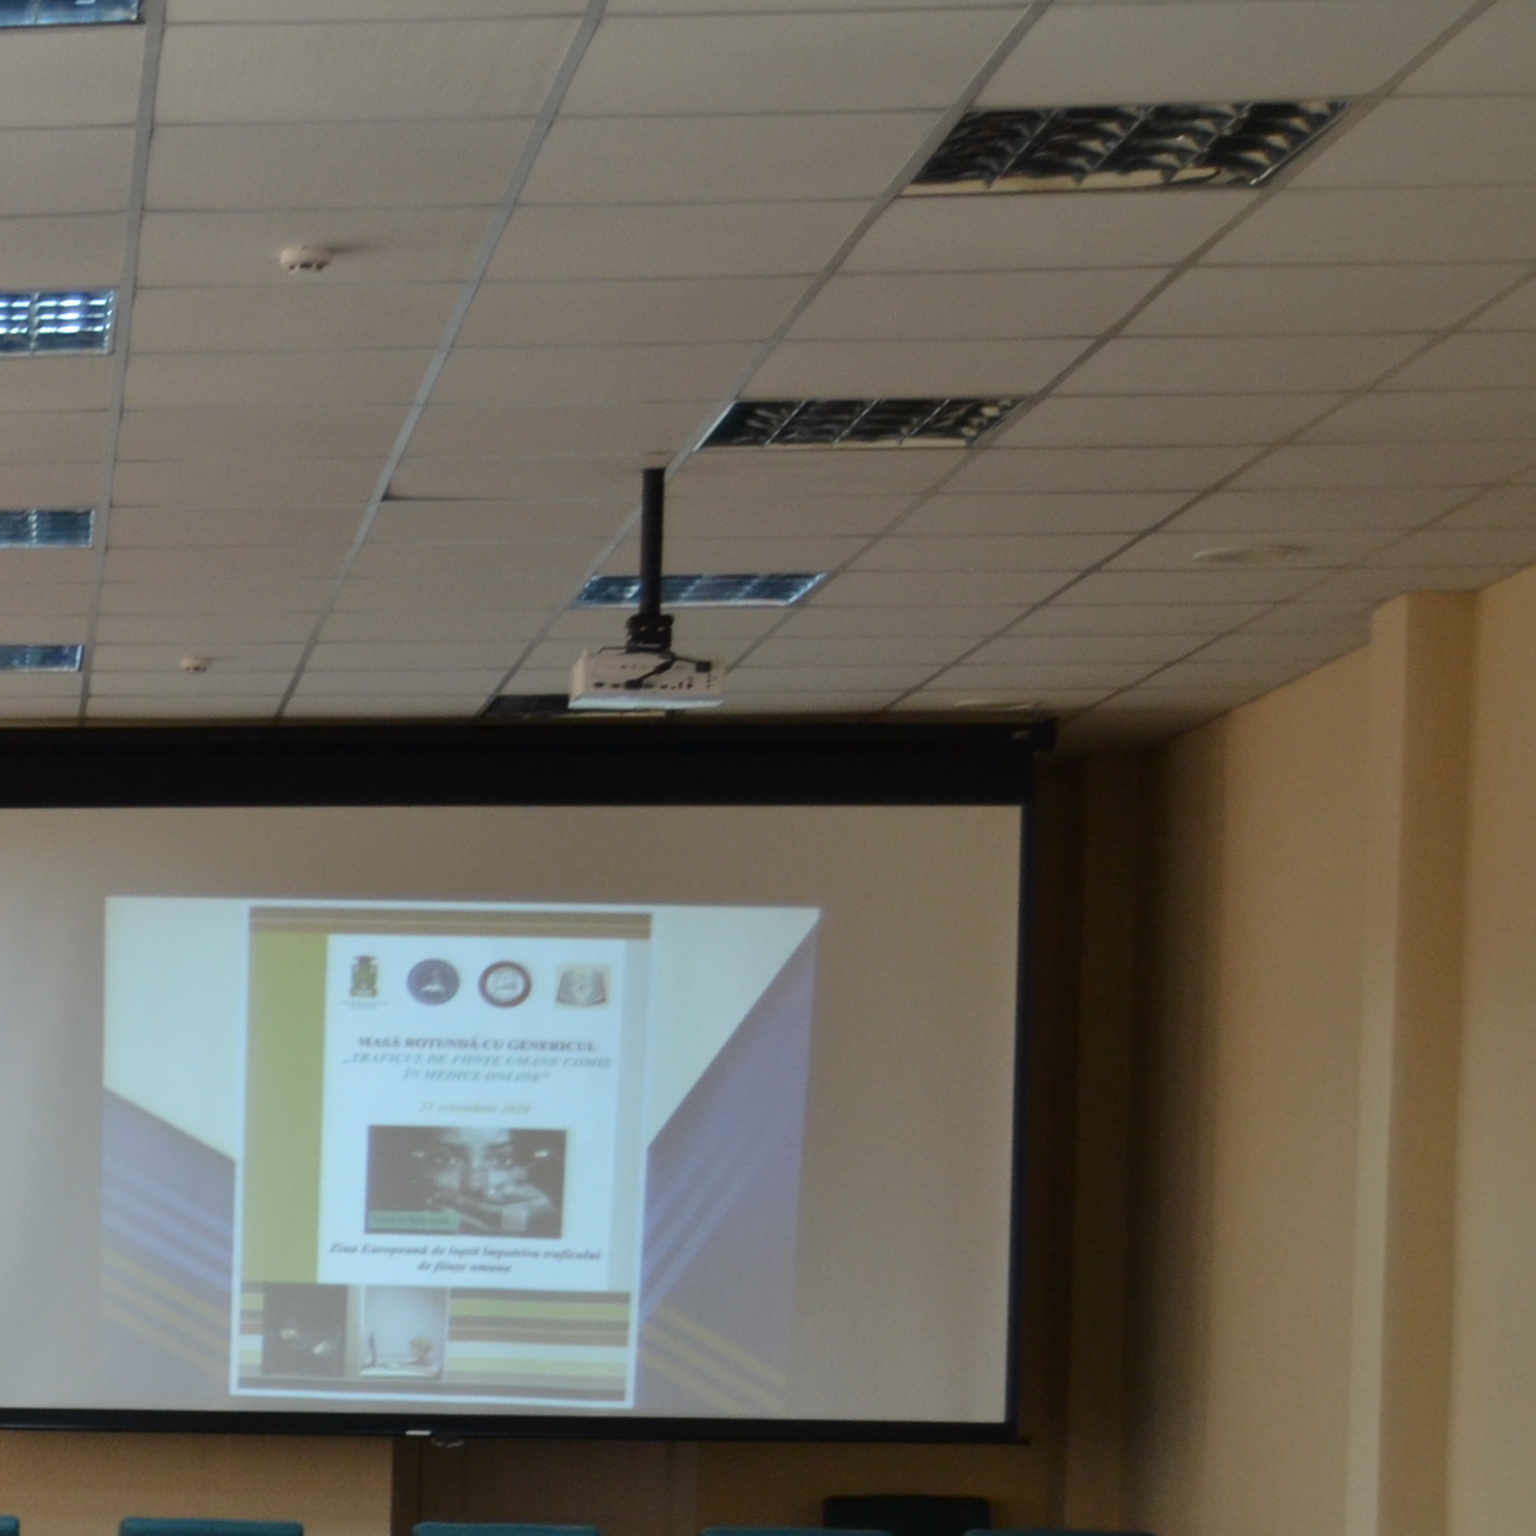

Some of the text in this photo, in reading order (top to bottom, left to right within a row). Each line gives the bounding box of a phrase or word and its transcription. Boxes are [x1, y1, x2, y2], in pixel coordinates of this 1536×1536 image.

[507, 1040, 598, 1053] GENERICUL
[542, 1249, 602, 1262] traficului
[470, 1264, 512, 1274] umane
